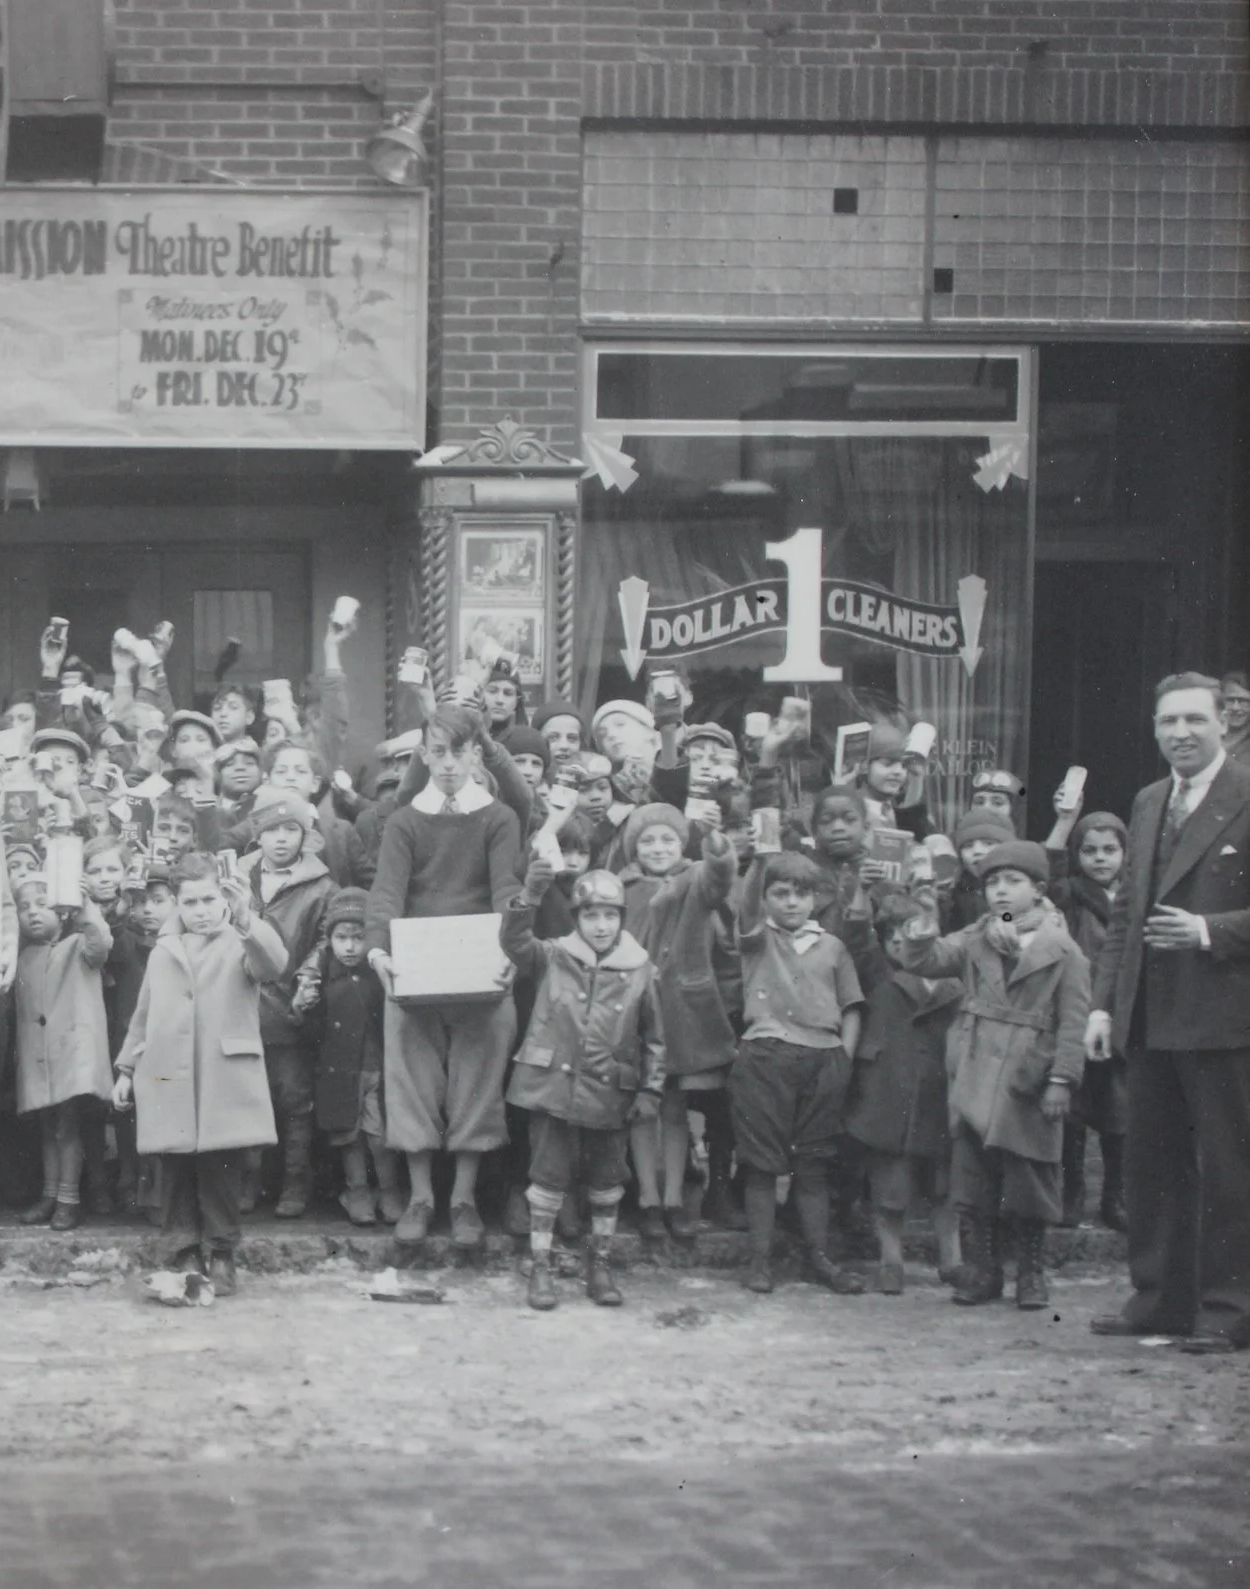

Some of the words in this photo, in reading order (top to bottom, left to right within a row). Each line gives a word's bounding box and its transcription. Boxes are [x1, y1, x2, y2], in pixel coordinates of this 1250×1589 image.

[114, 212, 231, 277] Theatre
[236, 221, 342, 279] Benefit
[238, 296, 289, 327] Only
[156, 370, 211, 407] FRI.
[650, 590, 781, 649] DOLLAR
[763, 527, 844, 682] 1
[827, 588, 958, 648] CLEANERS
[942, 739, 999, 757] KLEIN
